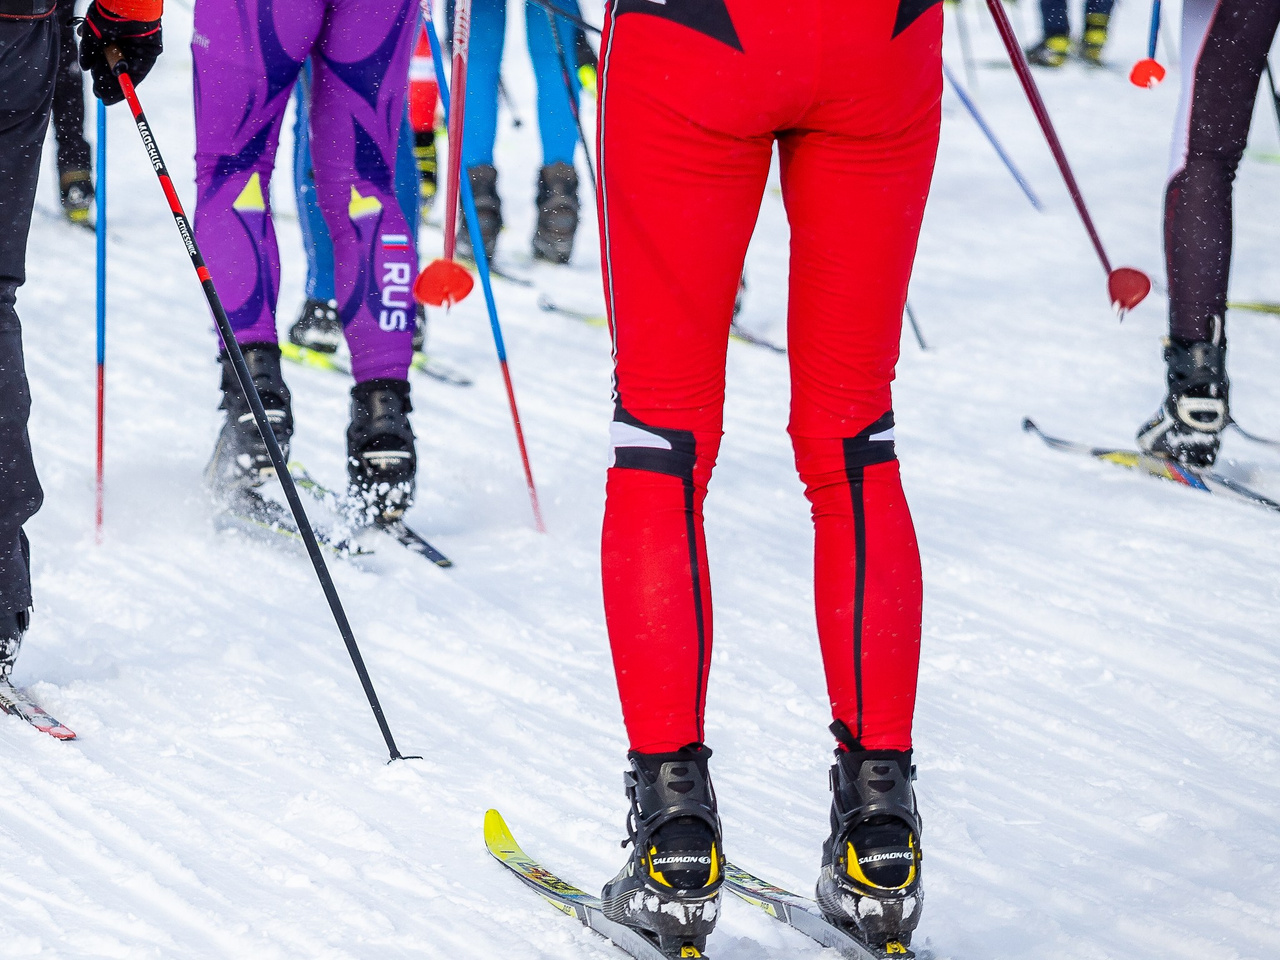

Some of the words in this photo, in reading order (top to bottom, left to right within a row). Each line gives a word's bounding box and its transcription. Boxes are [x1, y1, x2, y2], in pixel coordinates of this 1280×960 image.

[380, 262, 411, 331] RUS
[653, 856, 698, 865] SALOMON
[858, 852, 903, 864] SALOMON
